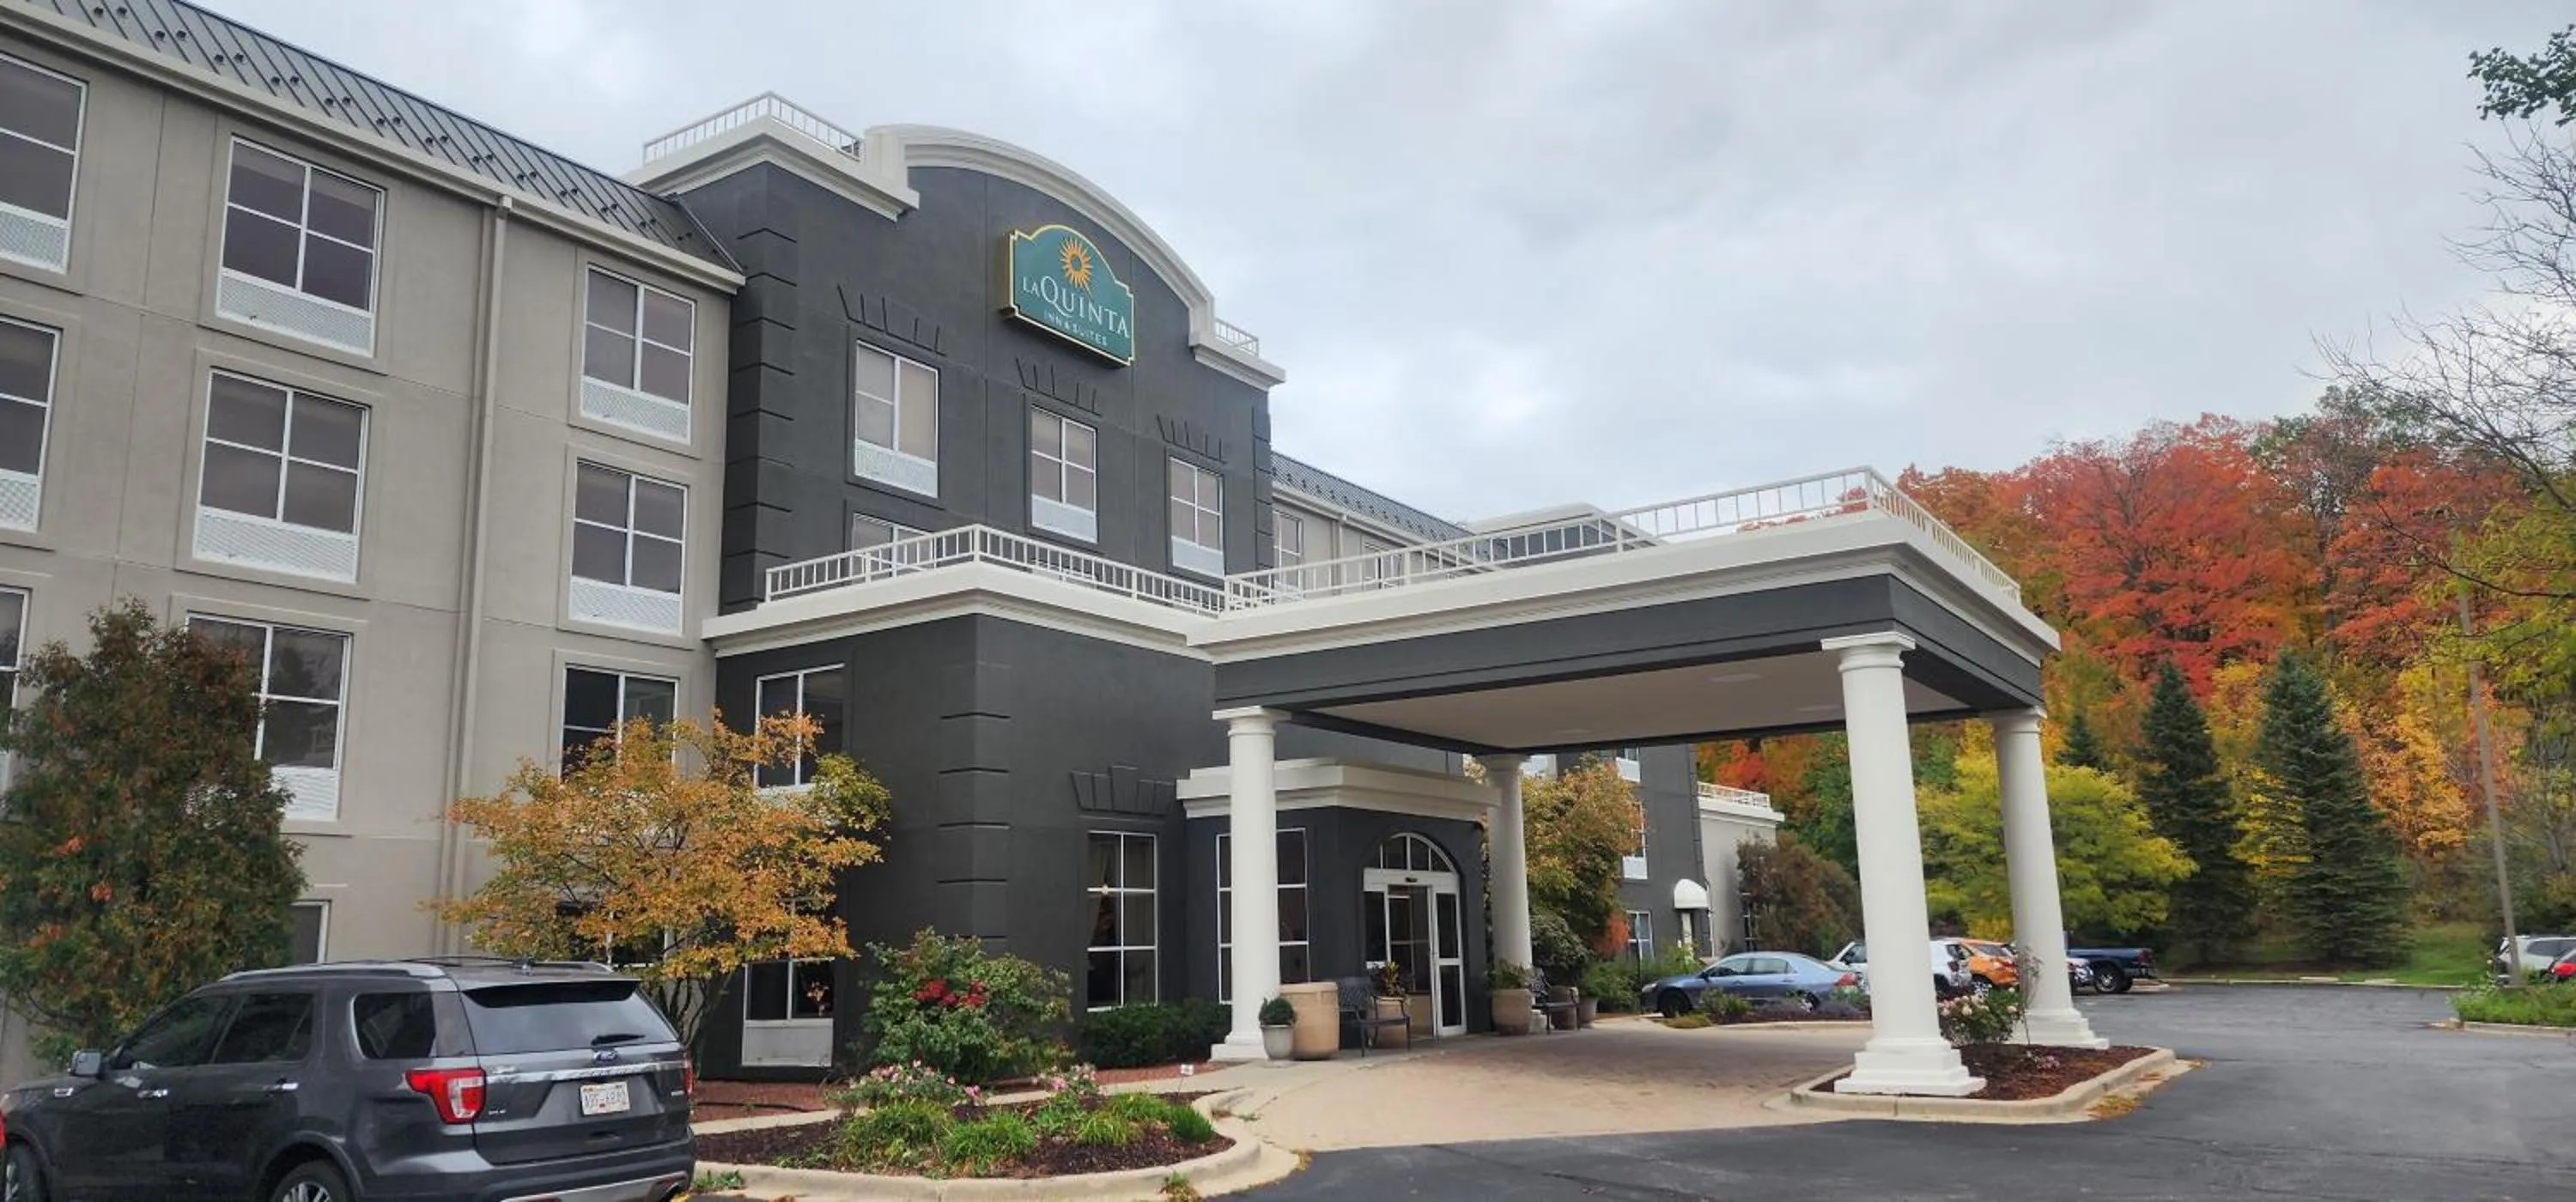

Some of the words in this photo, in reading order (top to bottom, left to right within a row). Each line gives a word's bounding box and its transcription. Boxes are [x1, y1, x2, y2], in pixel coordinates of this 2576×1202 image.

[1023, 276, 1040, 298] LA
[1041, 276, 1129, 339] QUINTA
[1044, 309, 1062, 327] INN
[1072, 324, 1108, 347] SUITES
